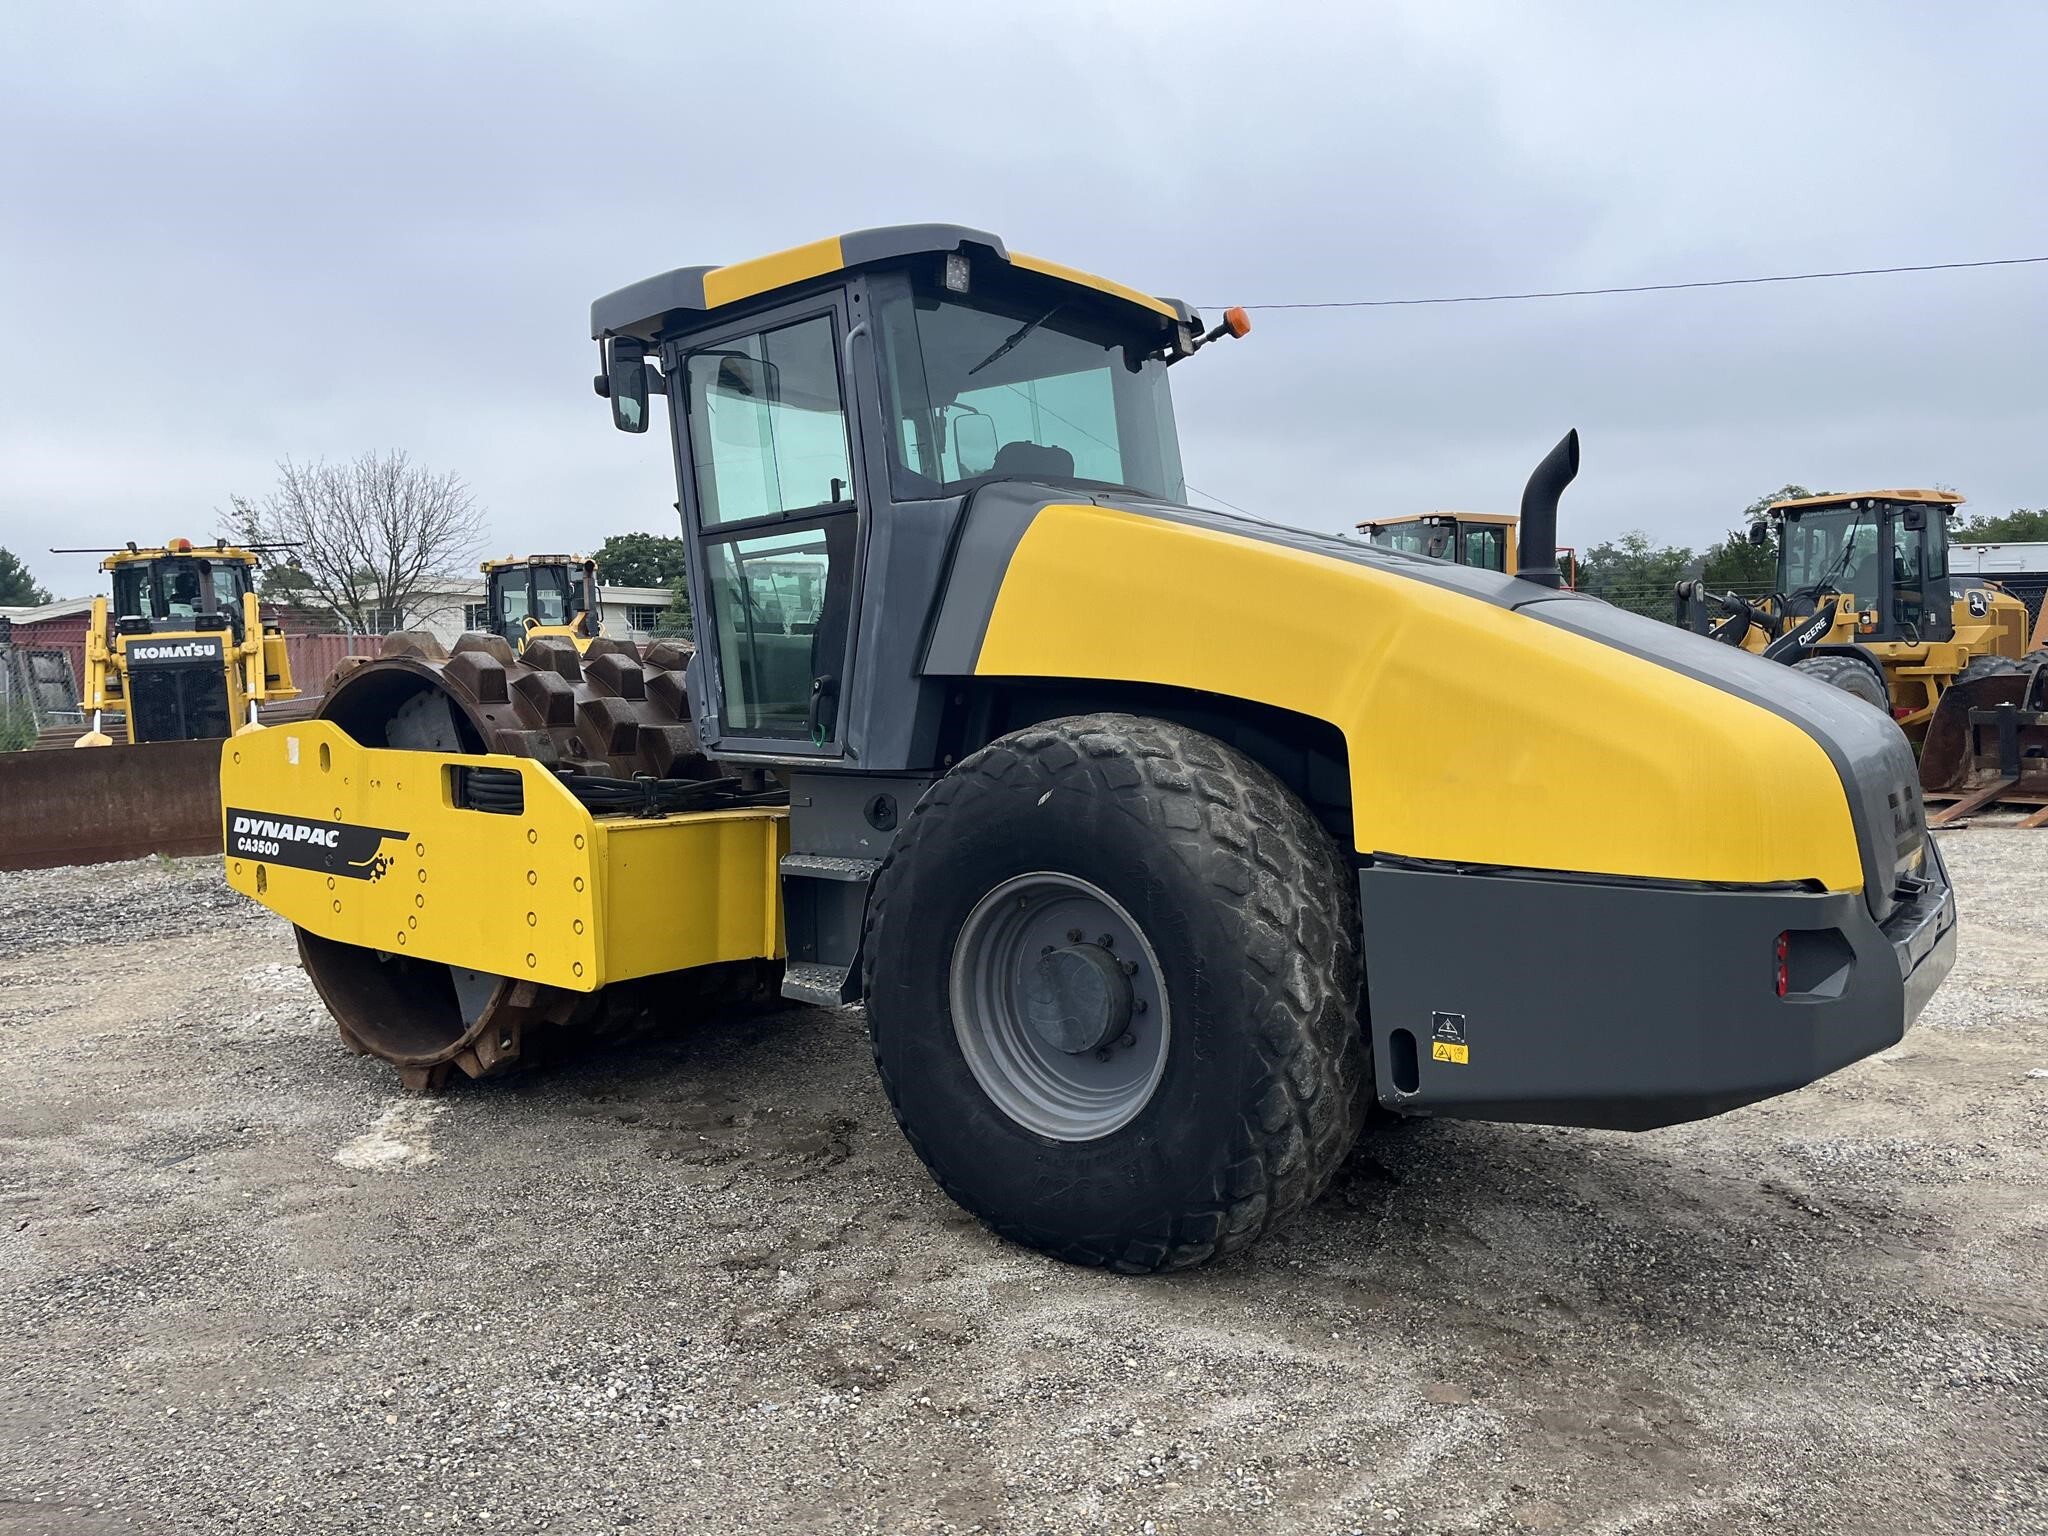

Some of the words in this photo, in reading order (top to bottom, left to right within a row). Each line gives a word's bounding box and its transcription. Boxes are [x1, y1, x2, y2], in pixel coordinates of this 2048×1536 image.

[1798, 617, 1828, 647] DEERE
[133, 643, 216, 660] KOMATSU
[233, 816, 340, 848] DYNAPAC
[237, 836, 280, 857] CA3500
